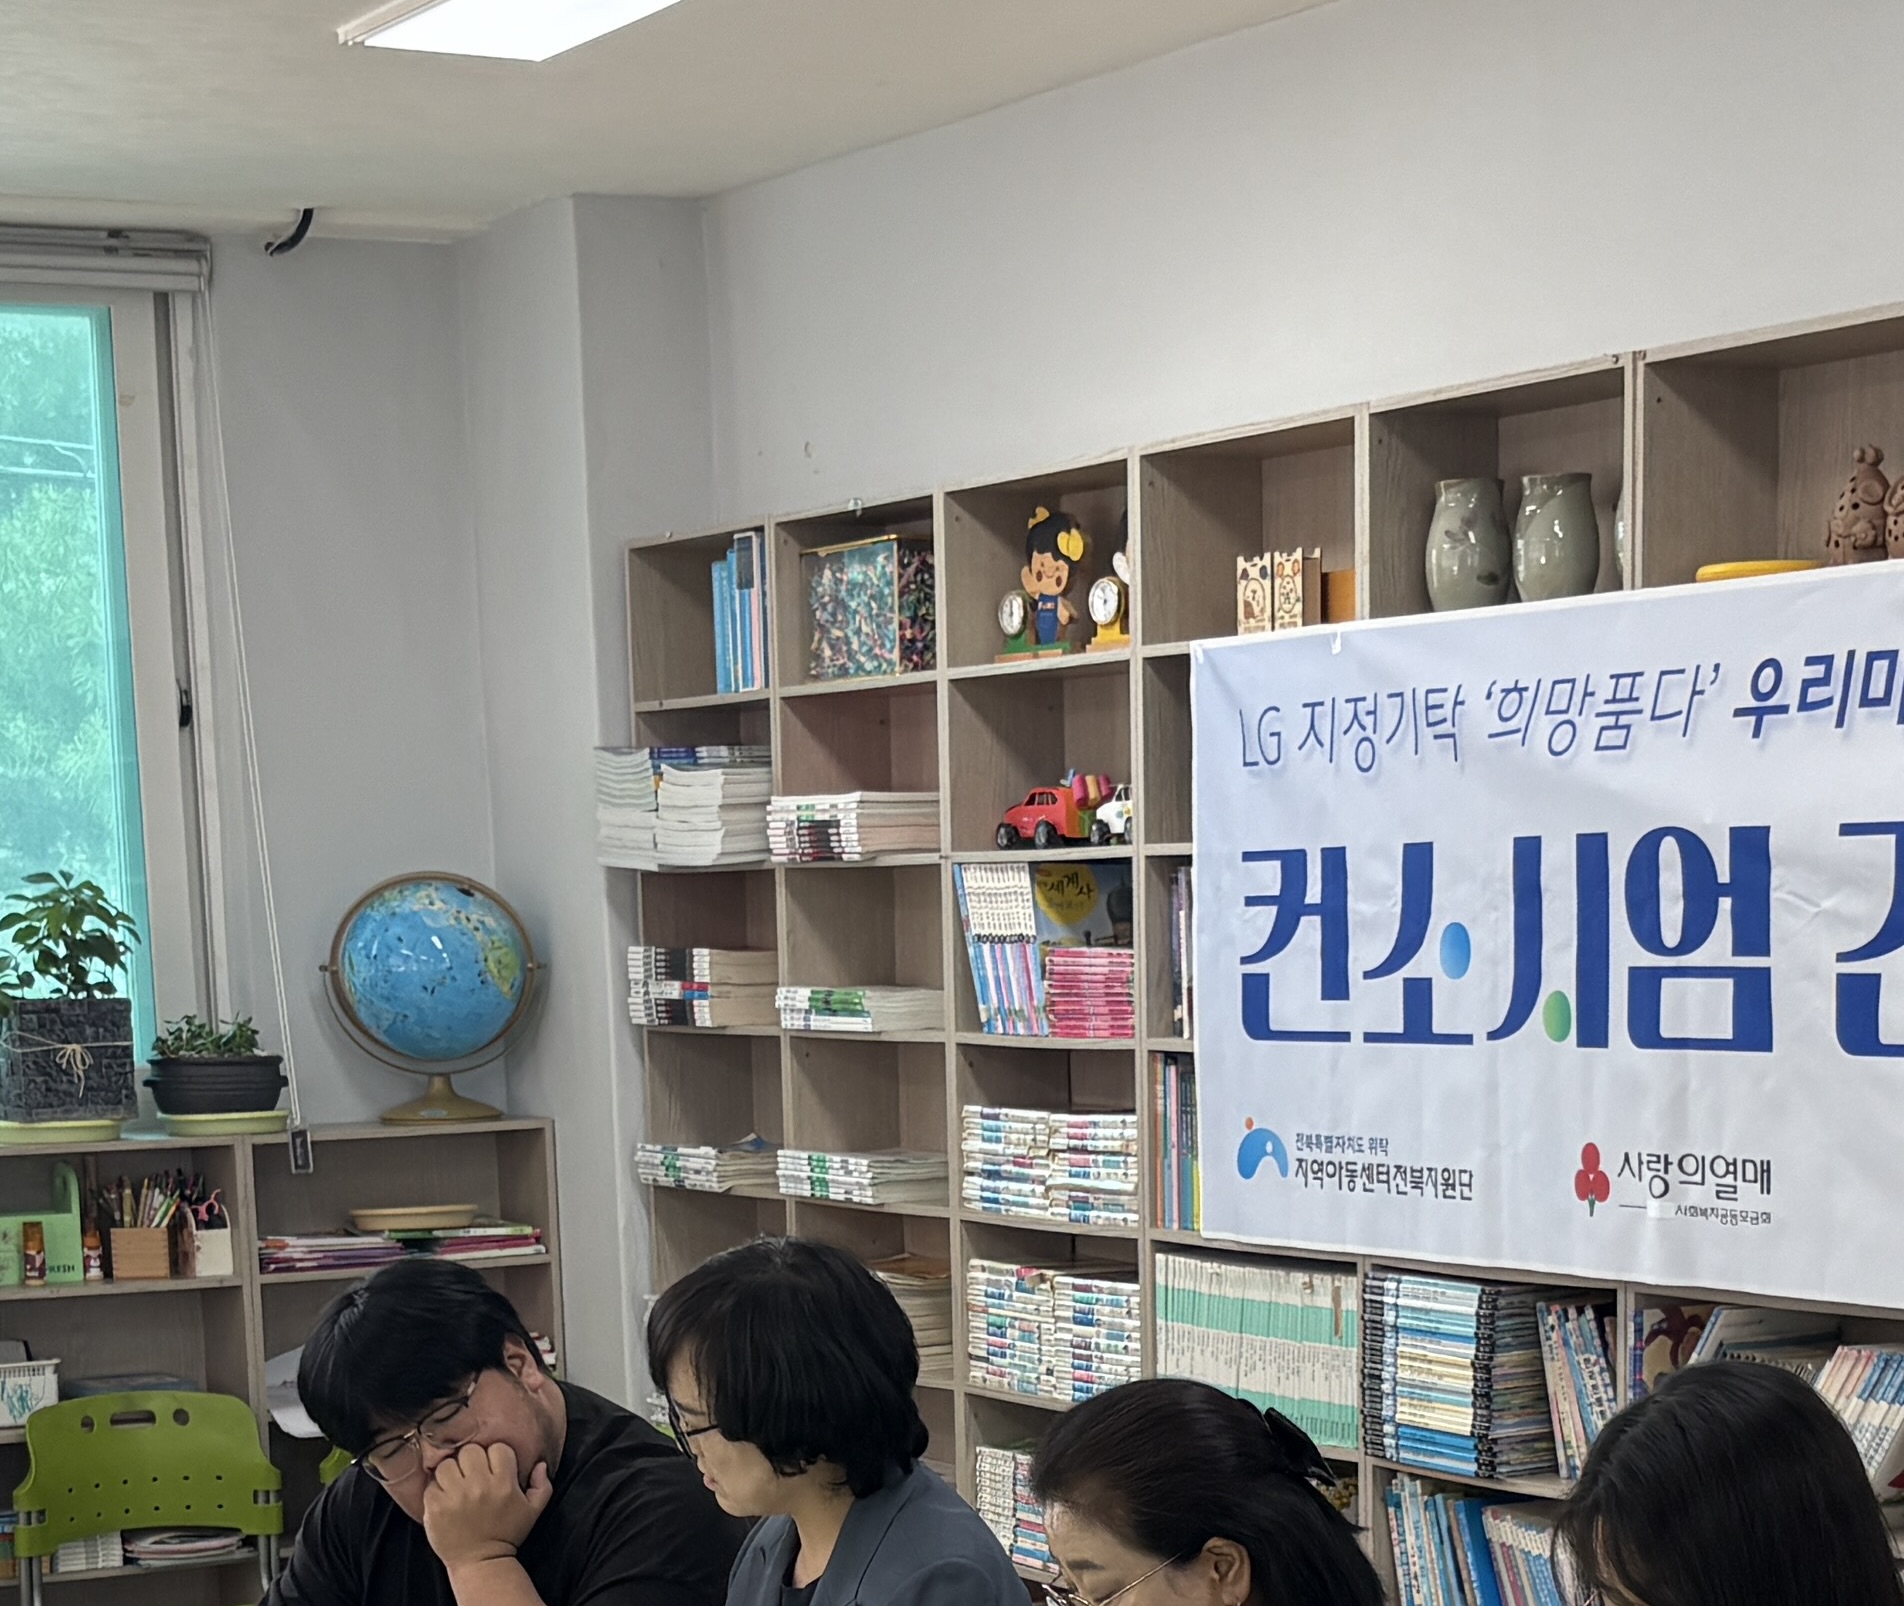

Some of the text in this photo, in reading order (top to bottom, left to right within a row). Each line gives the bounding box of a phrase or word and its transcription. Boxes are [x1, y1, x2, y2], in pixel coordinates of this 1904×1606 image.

[1239, 705, 1283, 769] LG
[1297, 684, 1466, 773] 지정기탁
[1239, 823, 1774, 1054] 컨소시엄
[1295, 1132, 1389, 1156] 전북특별자치도 위탁
[1295, 1157, 1474, 1202] 지역아동센터전북지원단
[1674, 1203, 1773, 1226] 사회복지공동모금회
